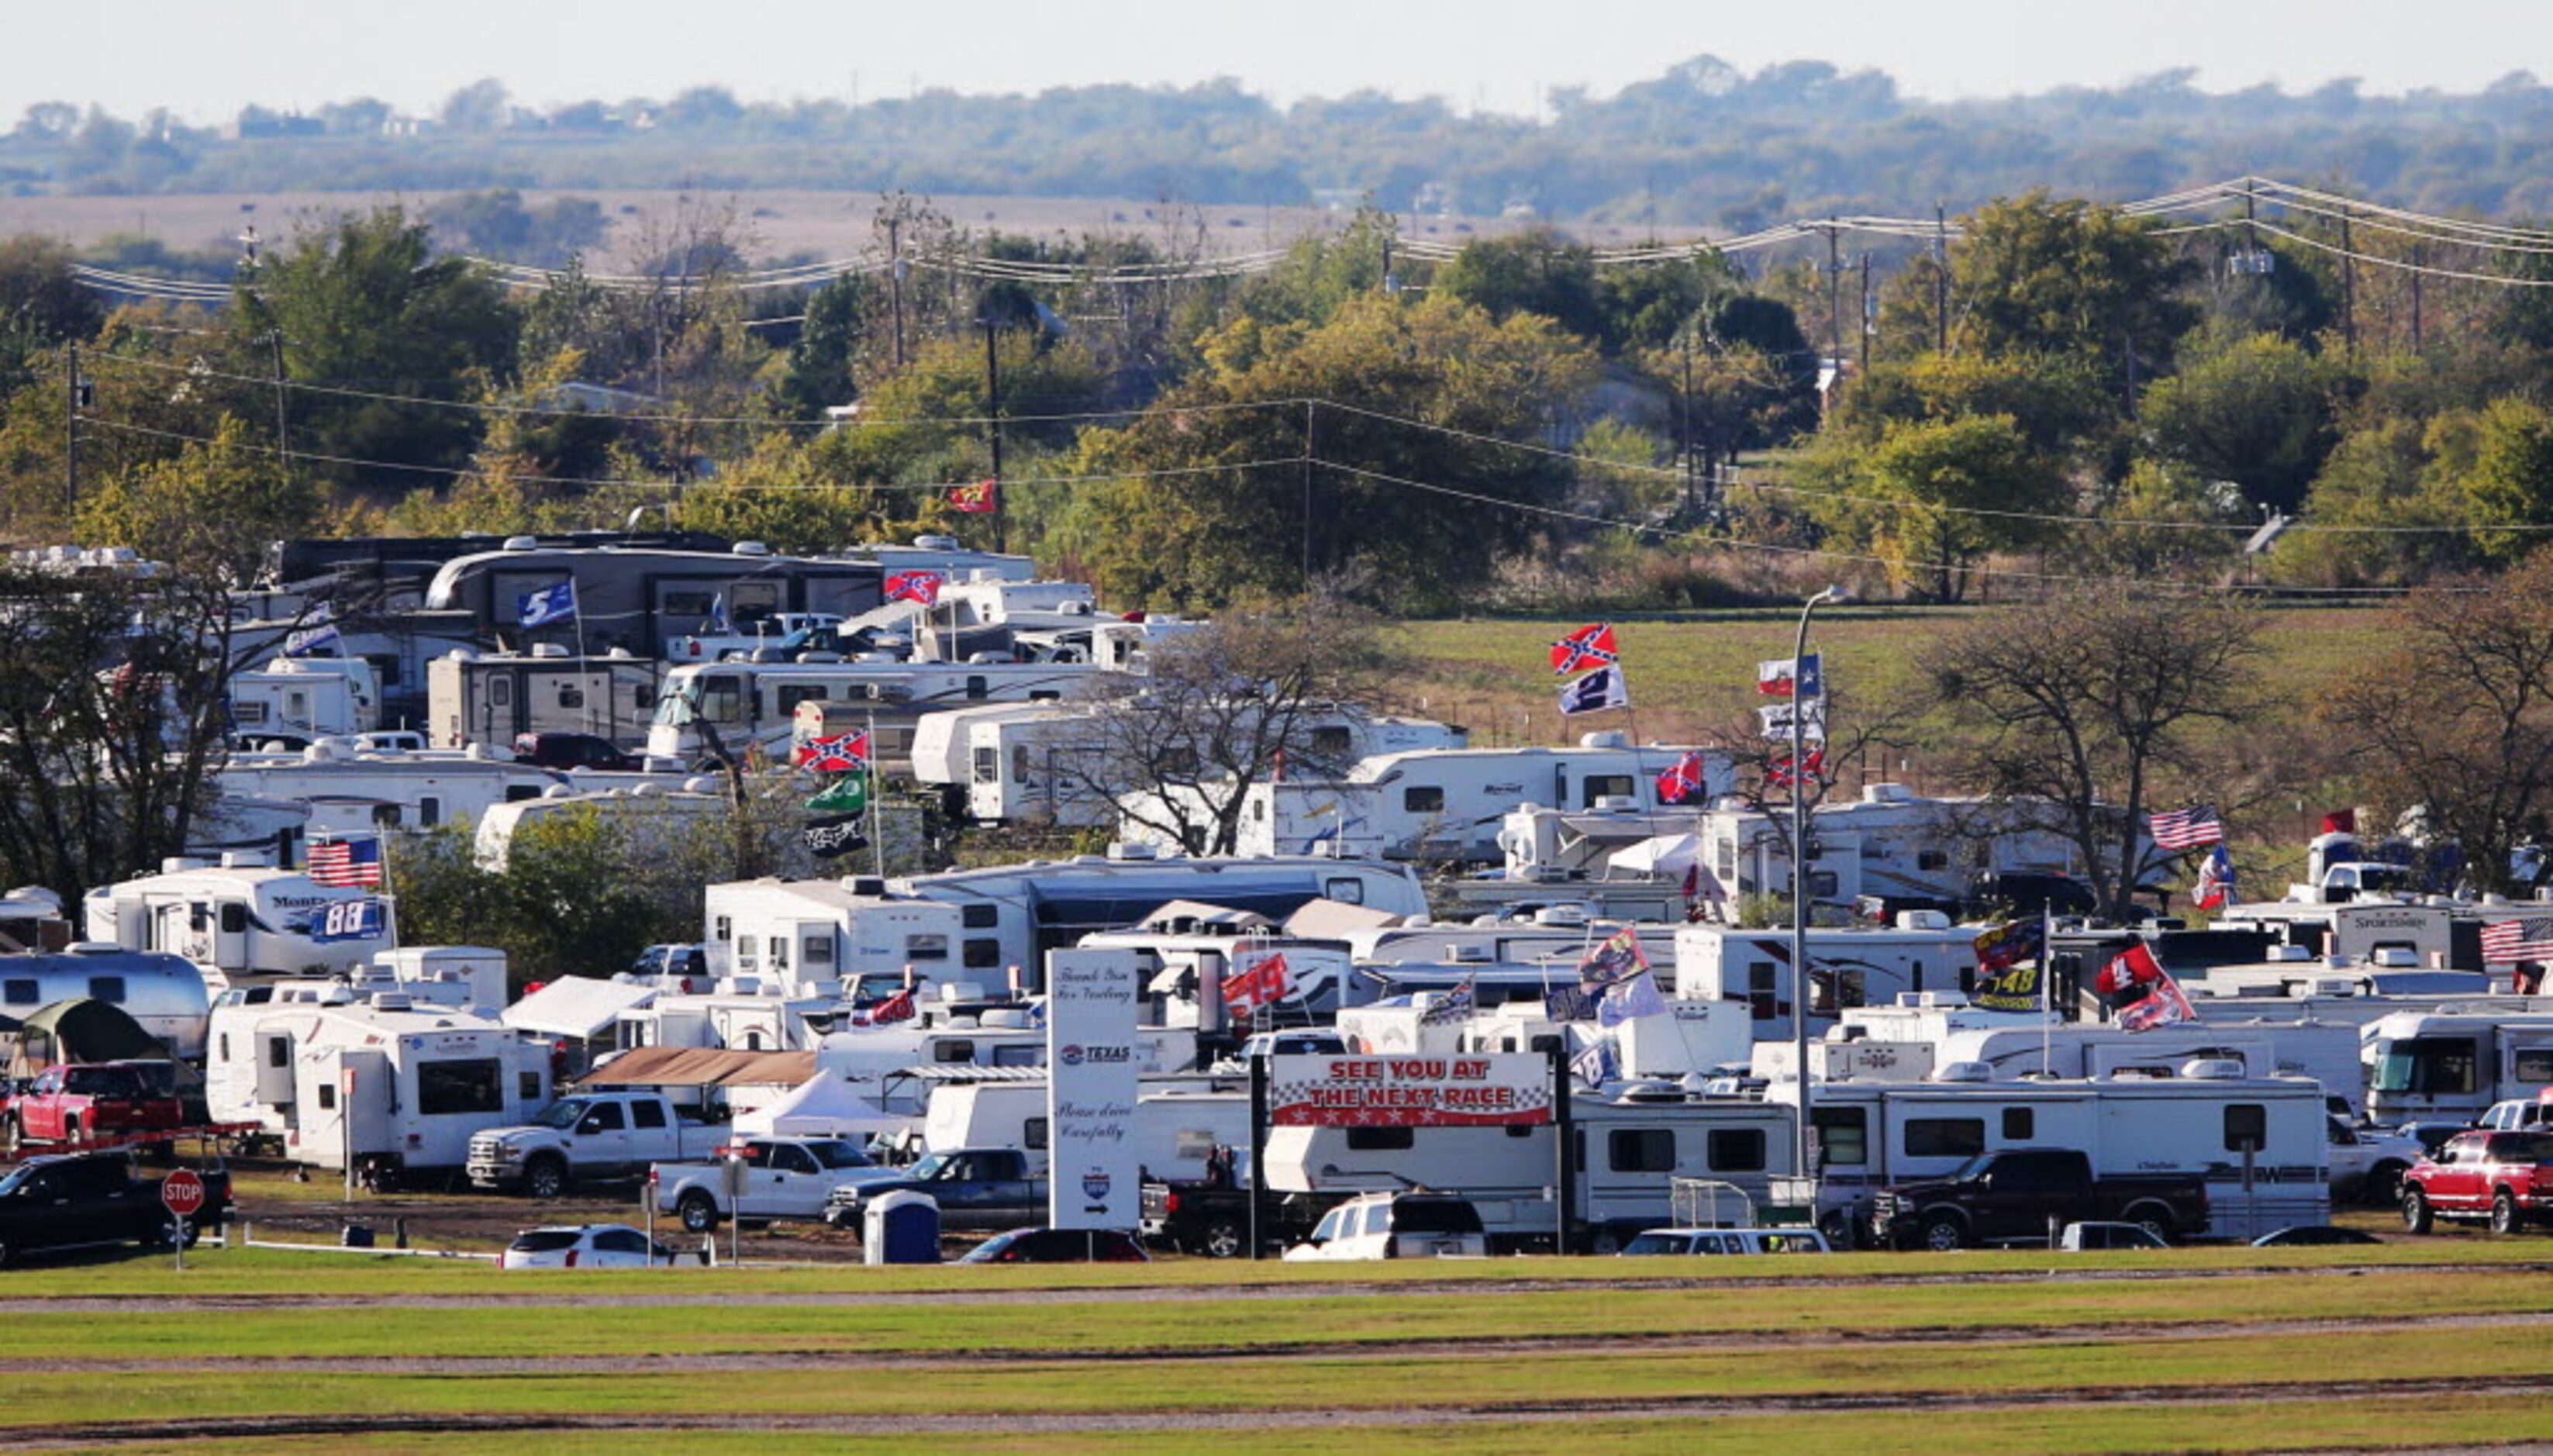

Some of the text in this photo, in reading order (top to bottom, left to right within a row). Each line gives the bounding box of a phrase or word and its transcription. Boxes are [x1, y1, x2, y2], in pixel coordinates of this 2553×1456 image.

[523, 589, 553, 626] 5
[326, 902, 365, 936] 88
[2003, 968, 2037, 993] 48
[2111, 956, 2134, 989] 4
[1086, 1046, 1131, 1058] TEXAS
[1330, 1060, 1490, 1079] SEE YOU AT
[1310, 1088, 1514, 1107] THE NEXT RACE
[166, 1183, 201, 1201] STOP
